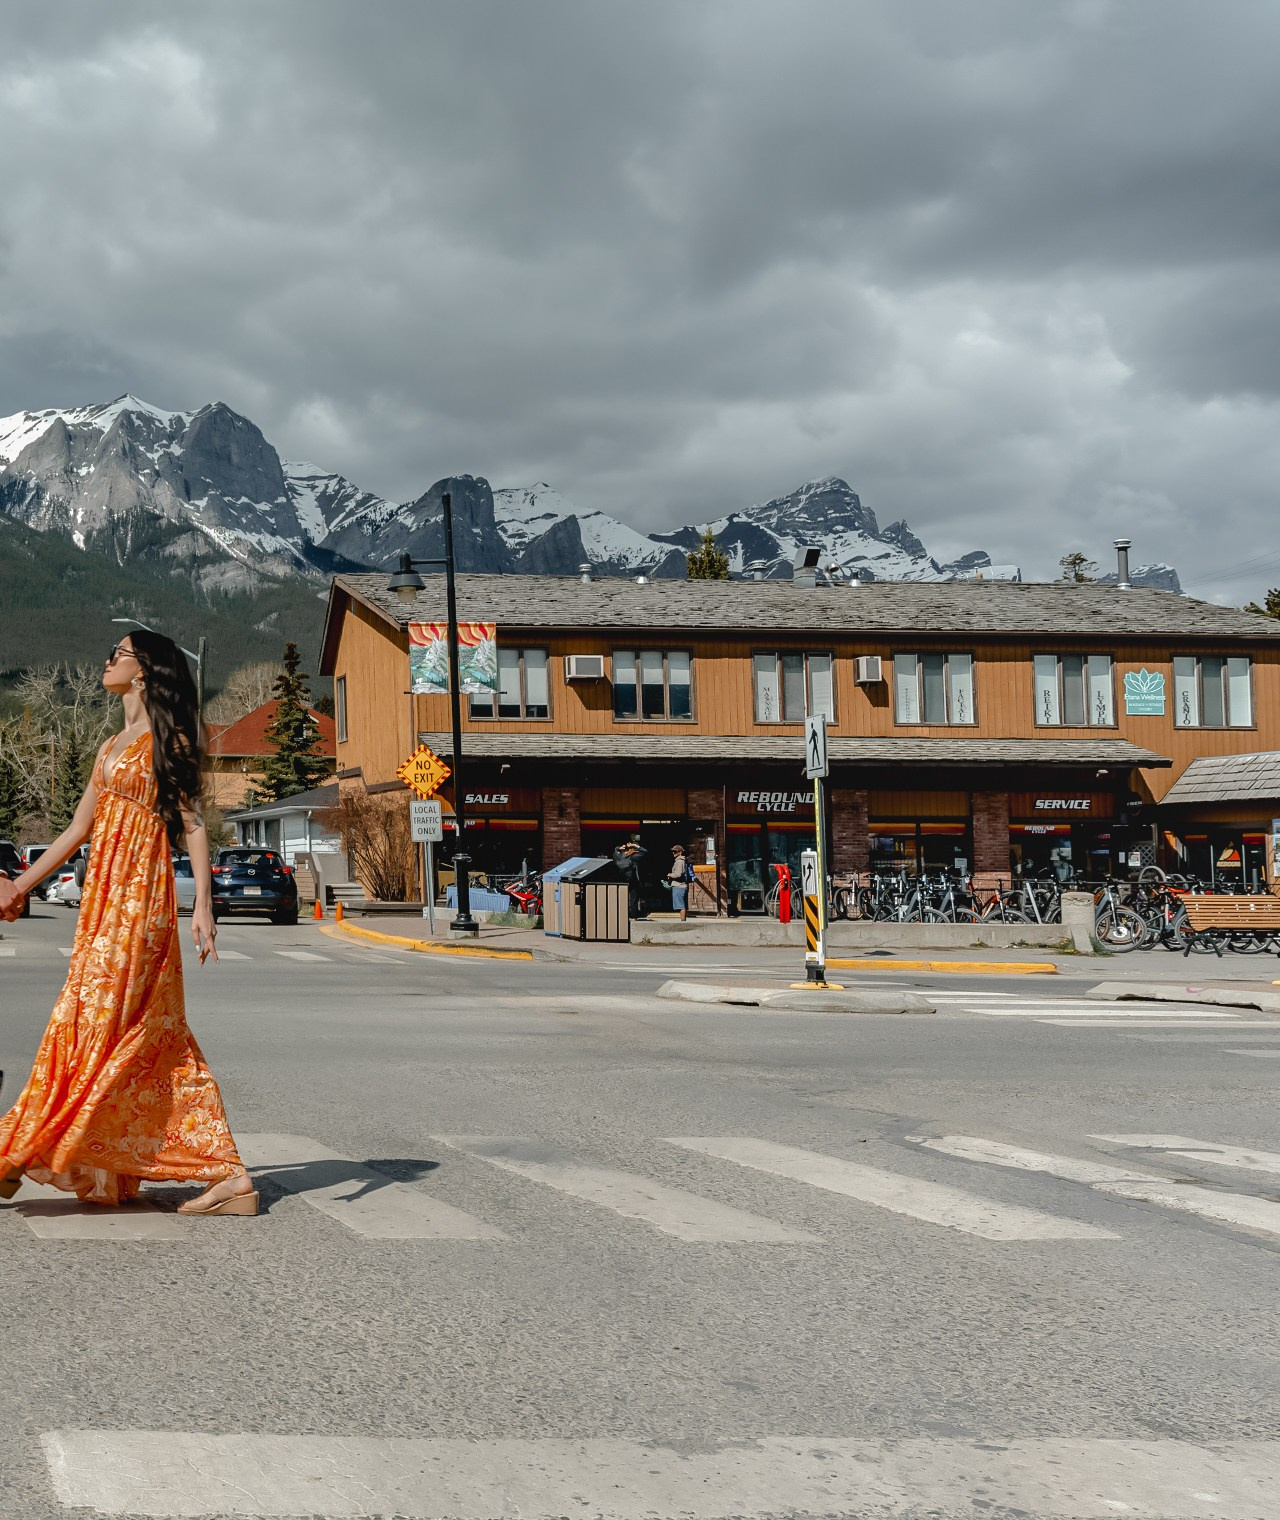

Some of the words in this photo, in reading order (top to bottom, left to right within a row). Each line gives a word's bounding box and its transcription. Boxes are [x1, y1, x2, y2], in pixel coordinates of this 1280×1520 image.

[1043, 689, 1051, 724] REIKI
[1096, 690, 1106, 725] LYMPH
[1182, 690, 1191, 726] CRANIO
[416, 760, 431, 770] NO
[414, 772, 435, 783] EXIT
[464, 793, 509, 804] SALES
[737, 791, 815, 803] REBOUND
[756, 802, 797, 812] CYCLE
[1035, 799, 1091, 809] SERVICE
[414, 806, 437, 814] LOCAL
[413, 816, 440, 824] TRAFFIC
[417, 827, 436, 835] ONLY
